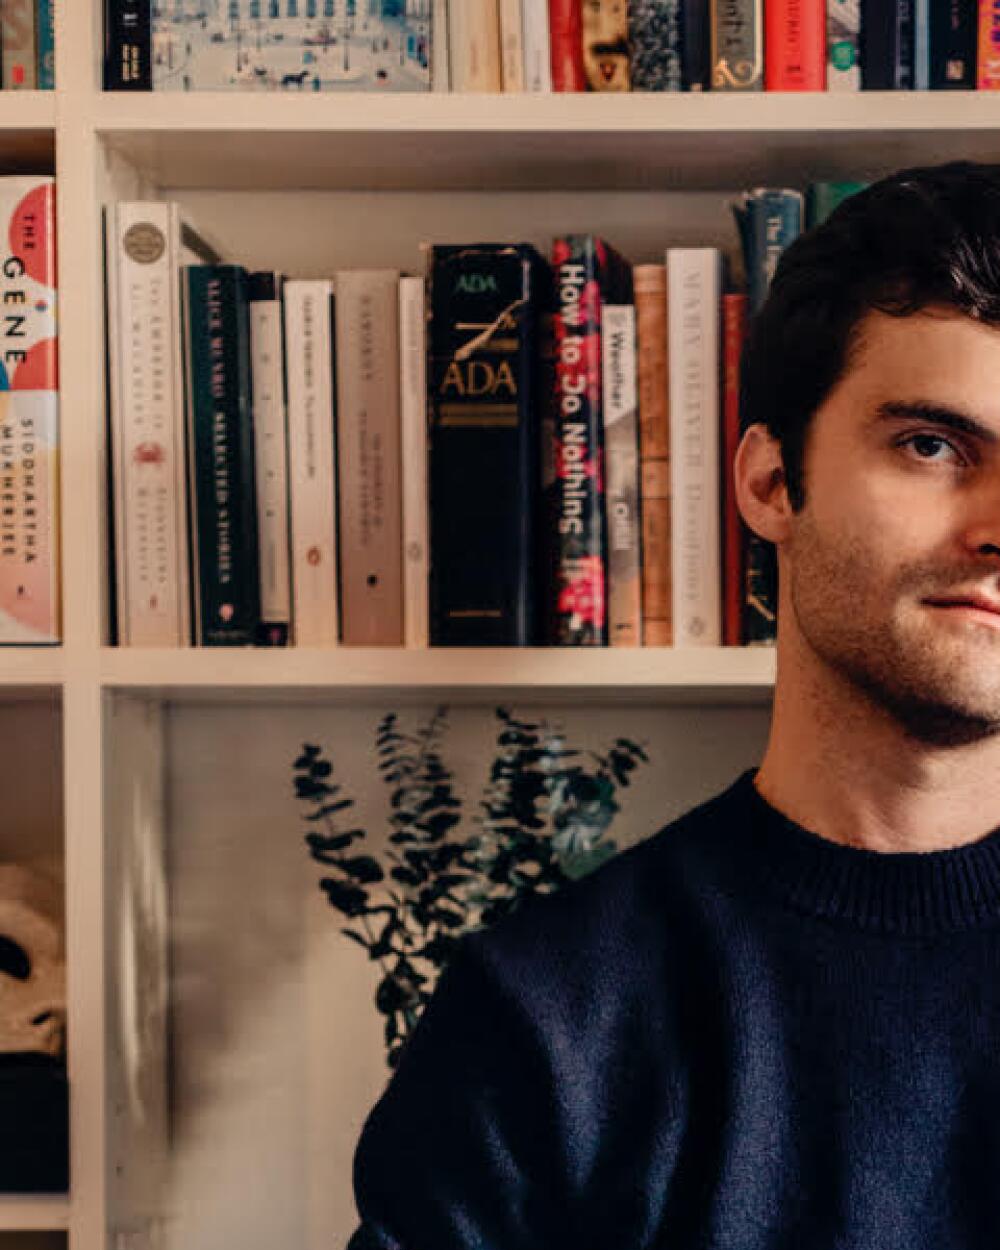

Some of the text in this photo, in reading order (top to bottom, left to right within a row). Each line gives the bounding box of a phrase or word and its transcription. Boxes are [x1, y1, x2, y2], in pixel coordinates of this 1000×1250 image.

[22, 213, 36, 250] THE
[3, 255, 27, 364] GENE
[561, 264, 585, 325] How
[440, 360, 518, 396] ADA
[562, 334, 586, 362] to
[22, 417, 38, 564] SIDDHARTHA
[558, 419, 588, 532] Nothing
